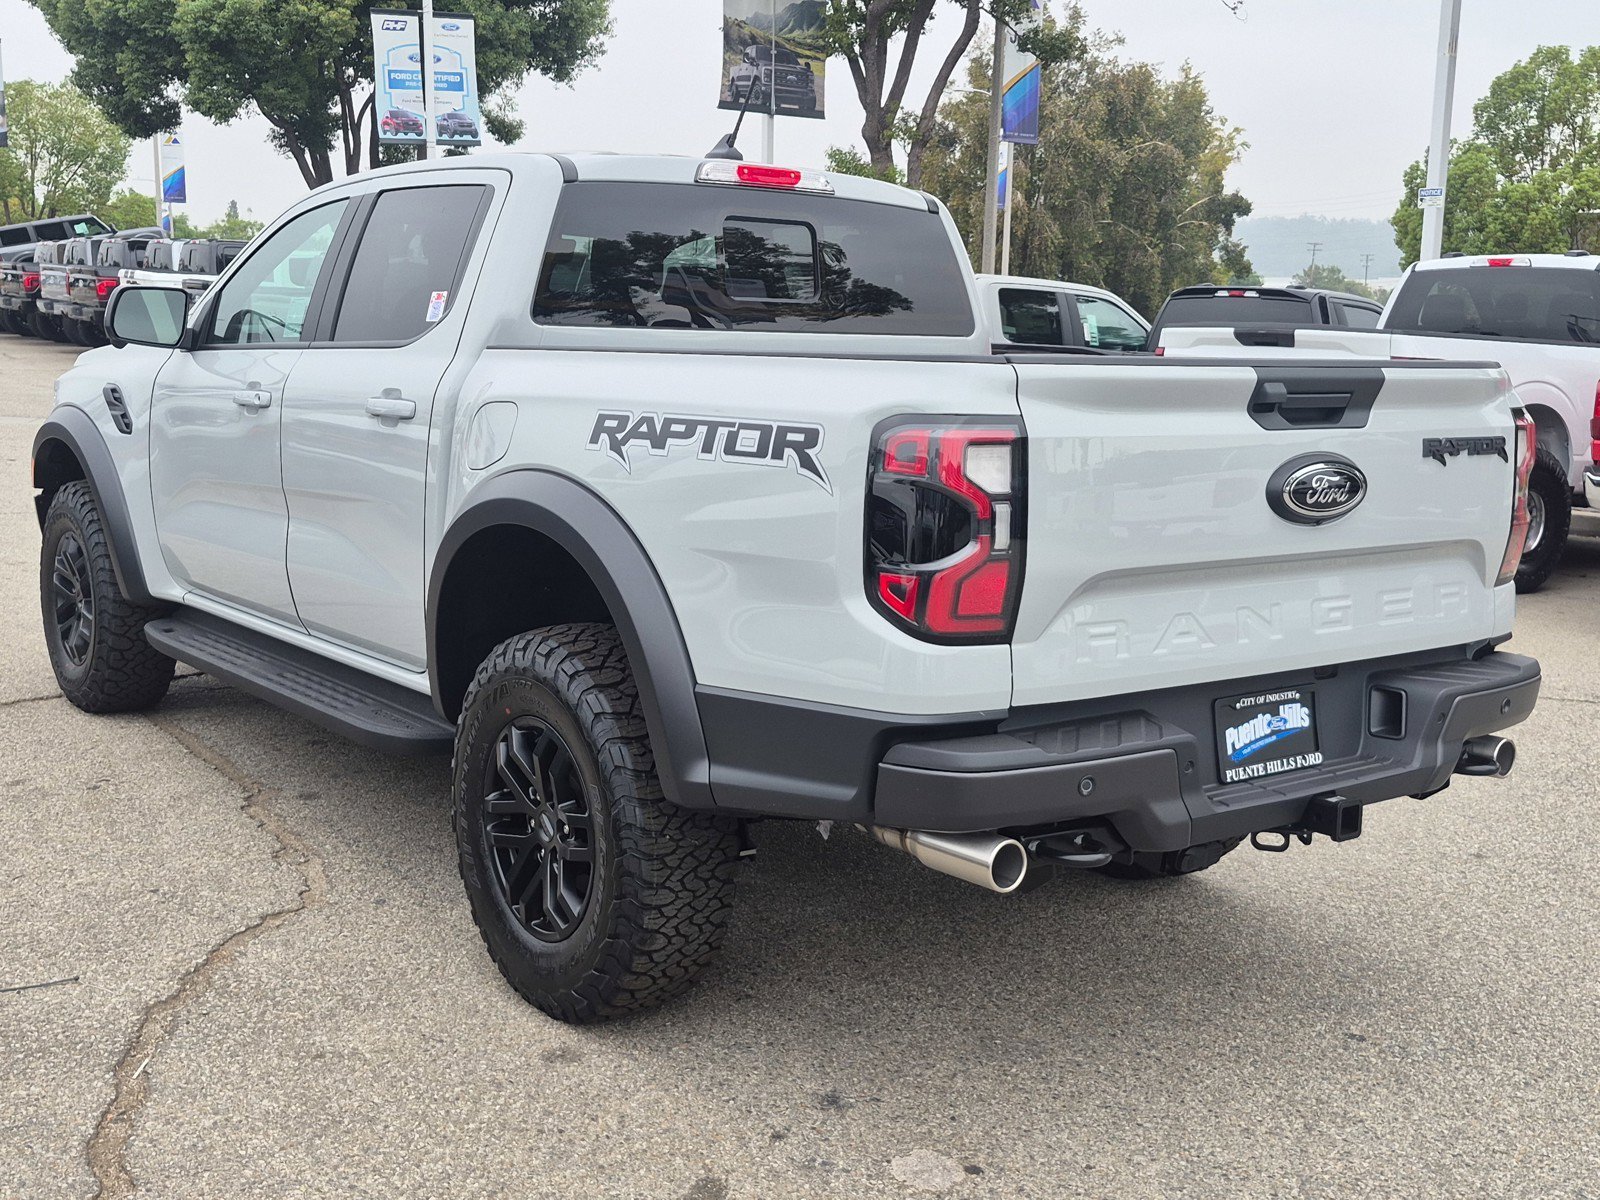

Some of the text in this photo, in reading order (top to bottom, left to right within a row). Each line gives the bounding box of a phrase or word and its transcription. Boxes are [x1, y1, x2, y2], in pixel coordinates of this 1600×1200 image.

[391, 72, 412, 80] FORD
[587, 411, 831, 492] RAPTOR
[1422, 436, 1508, 467] RAPTOR
[1306, 475, 1351, 504] Ford
[1075, 581, 1470, 663] RANGER
[1240, 690, 1297, 706] CITY OF INDUSTRY
[1225, 702, 1310, 756] Puente Hills
[1225, 752, 1323, 782] PUENTE HILLS FORD
